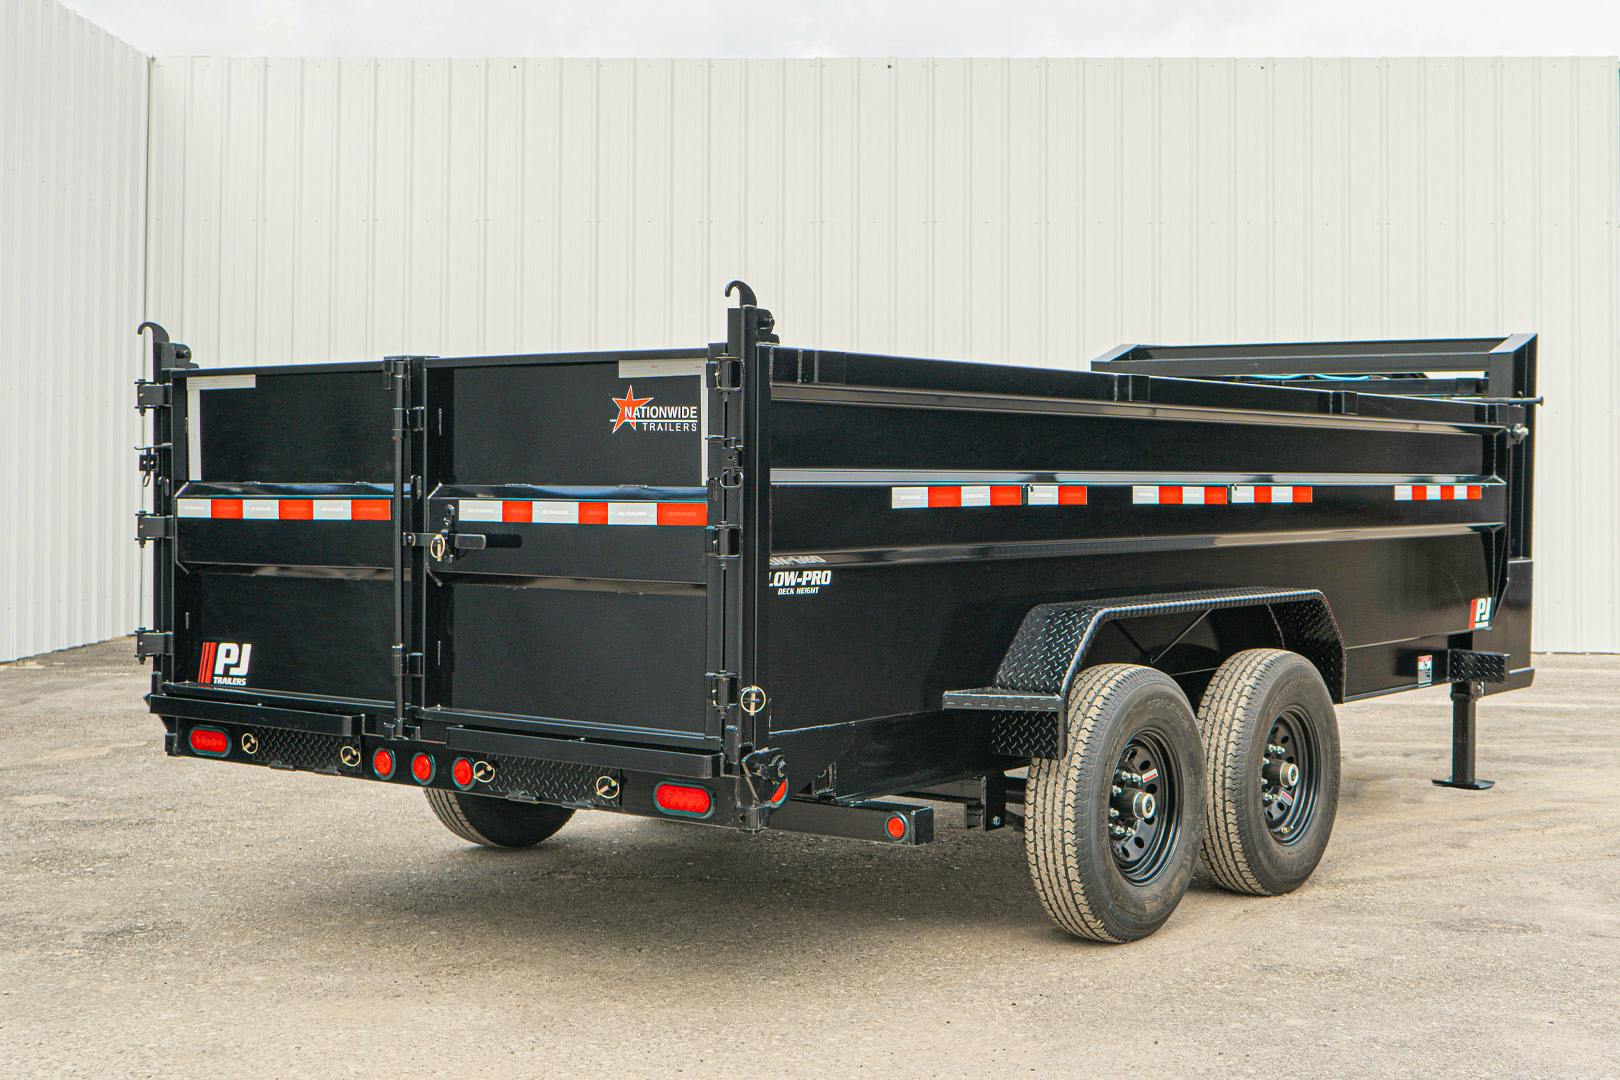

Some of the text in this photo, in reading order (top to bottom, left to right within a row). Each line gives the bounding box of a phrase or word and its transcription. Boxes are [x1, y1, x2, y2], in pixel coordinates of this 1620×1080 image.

[624, 406, 698, 419] NATIONWIDE
[642, 422, 697, 432] TRAILERS
[769, 570, 832, 587] LOW-PRO
[777, 586, 820, 595] DECK HEIGHT
[1475, 597, 1492, 622] PJ
[214, 642, 252, 676] PJ
[213, 676, 247, 687] TRAILERS
